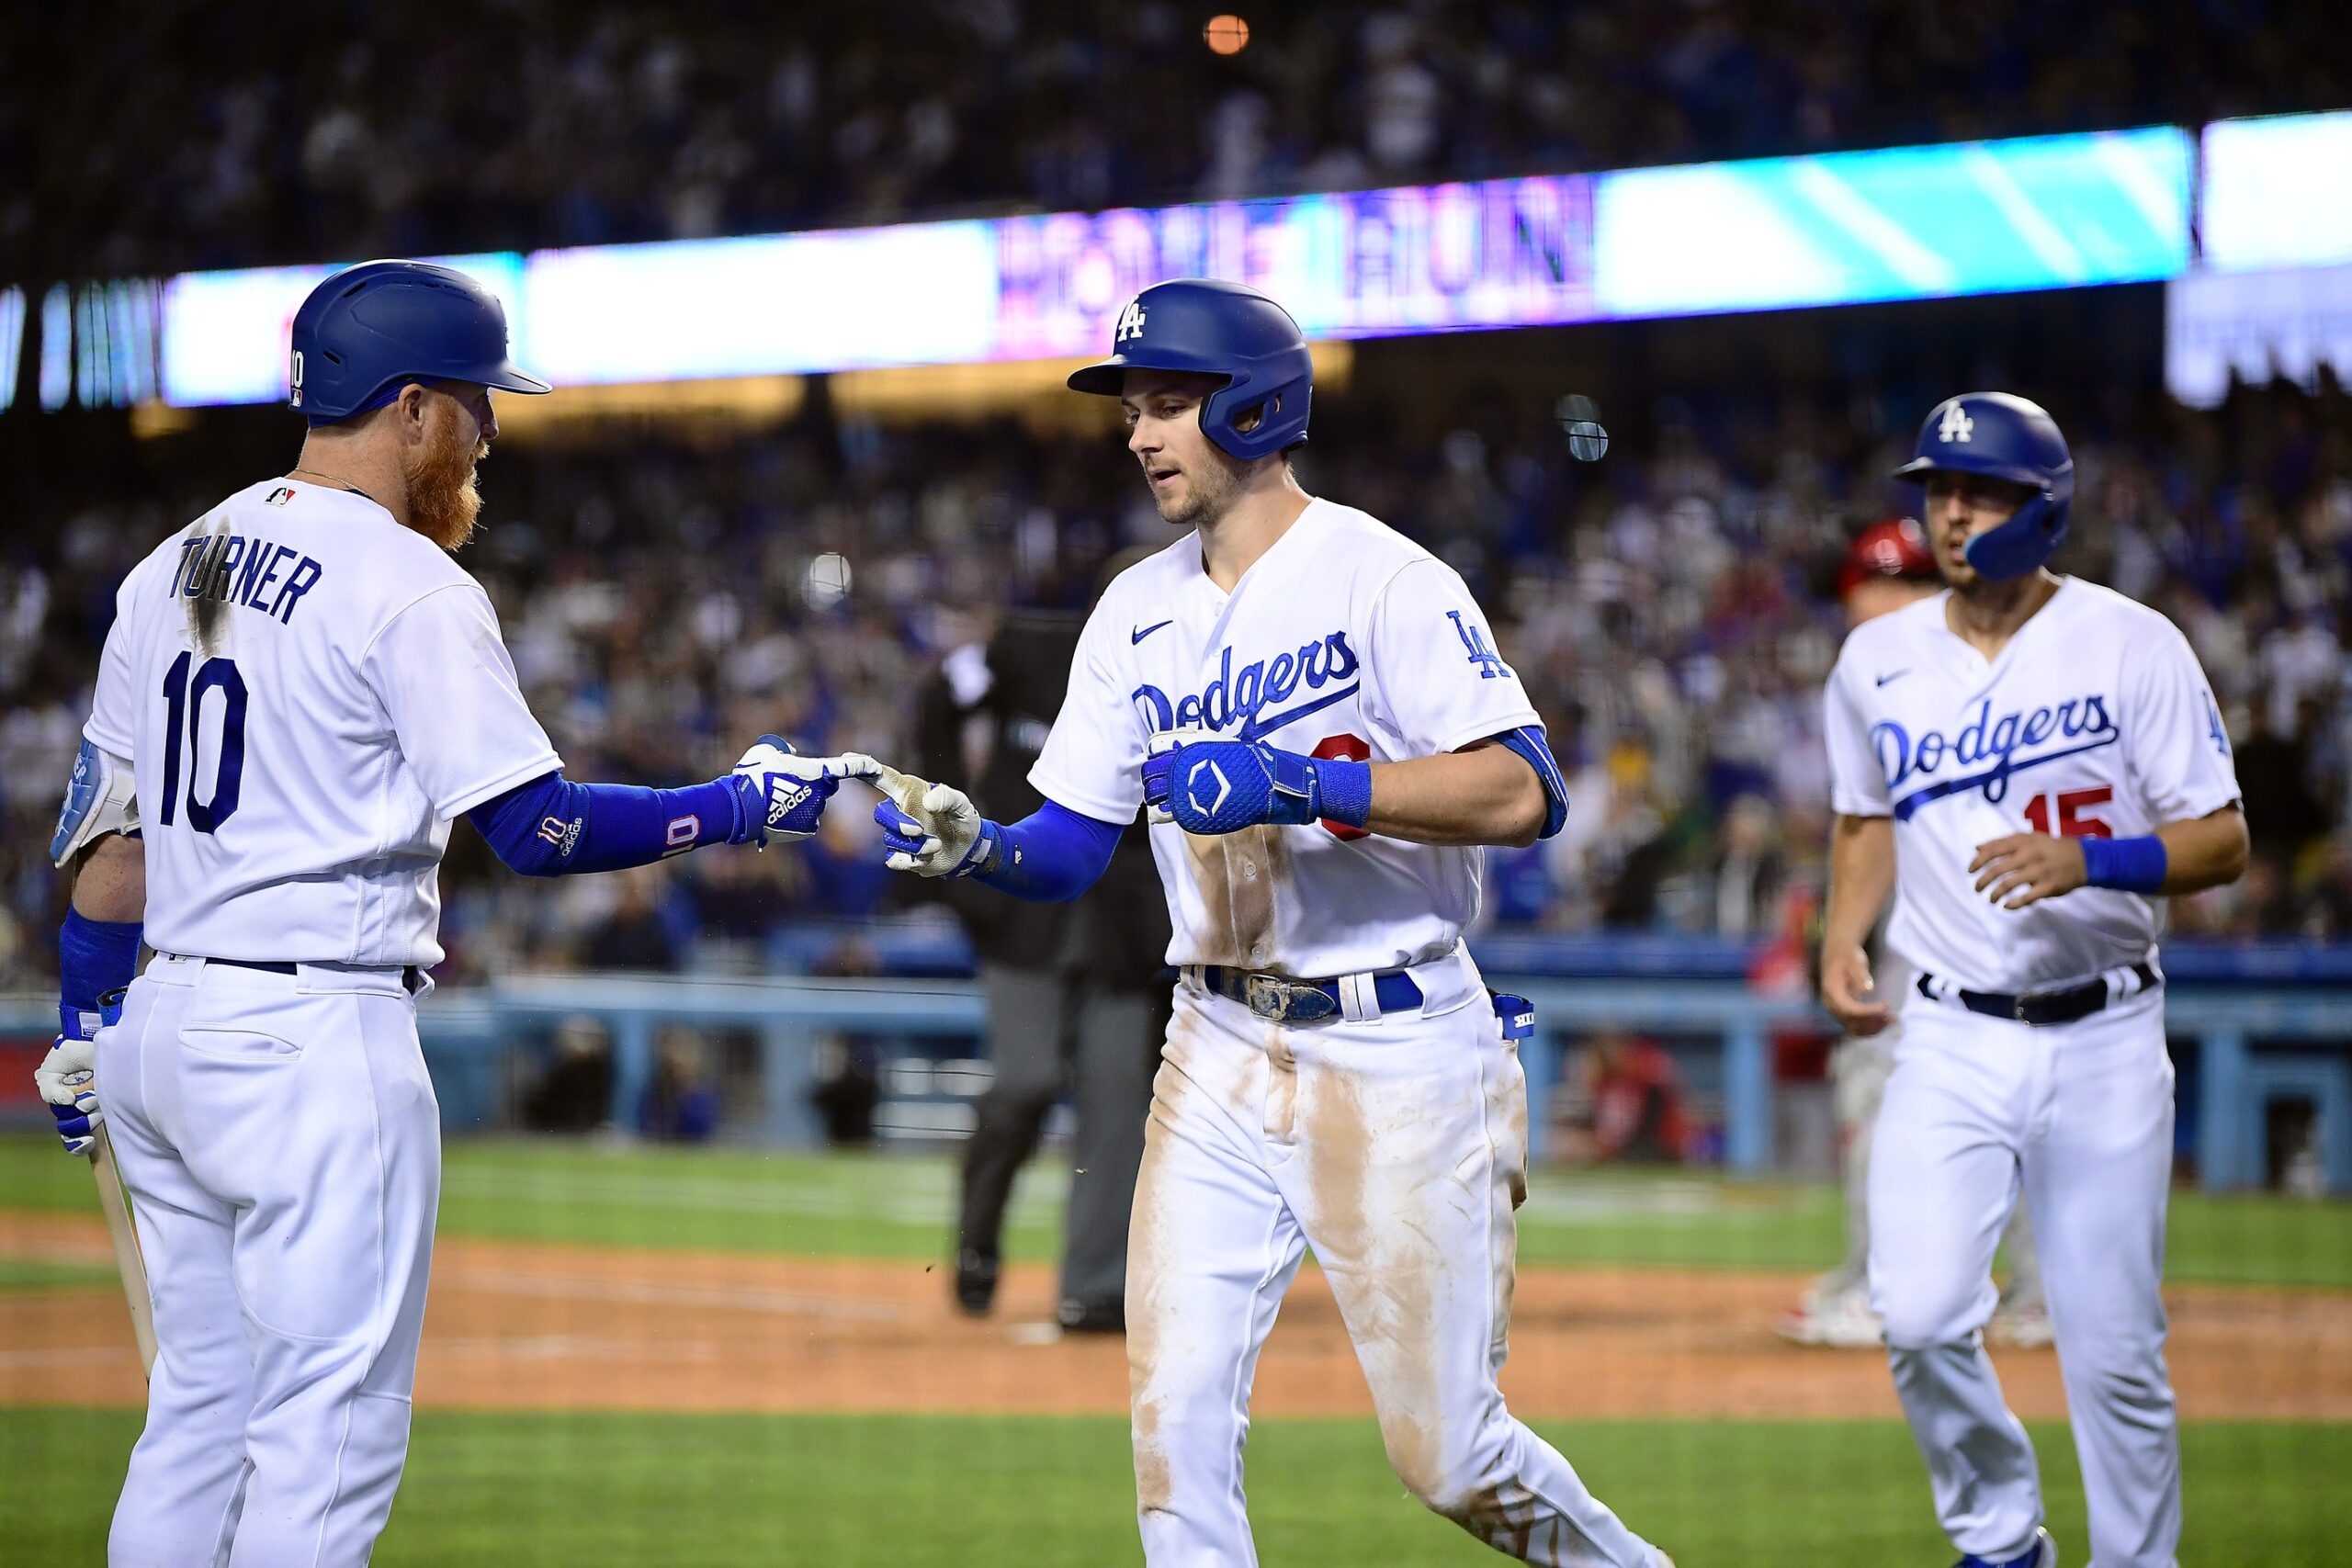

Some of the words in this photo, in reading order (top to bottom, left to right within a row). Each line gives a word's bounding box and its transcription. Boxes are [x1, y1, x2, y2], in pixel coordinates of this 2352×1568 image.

[1117, 294, 1146, 342] LA
[1939, 400, 1973, 443] LA
[169, 535, 322, 626] TURNER
[1446, 610, 1510, 679] LA
[1131, 630, 1361, 743] Dodgers
[160, 649, 249, 836] 10
[1872, 694, 2118, 804] Dodgers
[537, 816, 568, 845] 10
[767, 785, 812, 825] adidas
[561, 818, 583, 857] adidas
